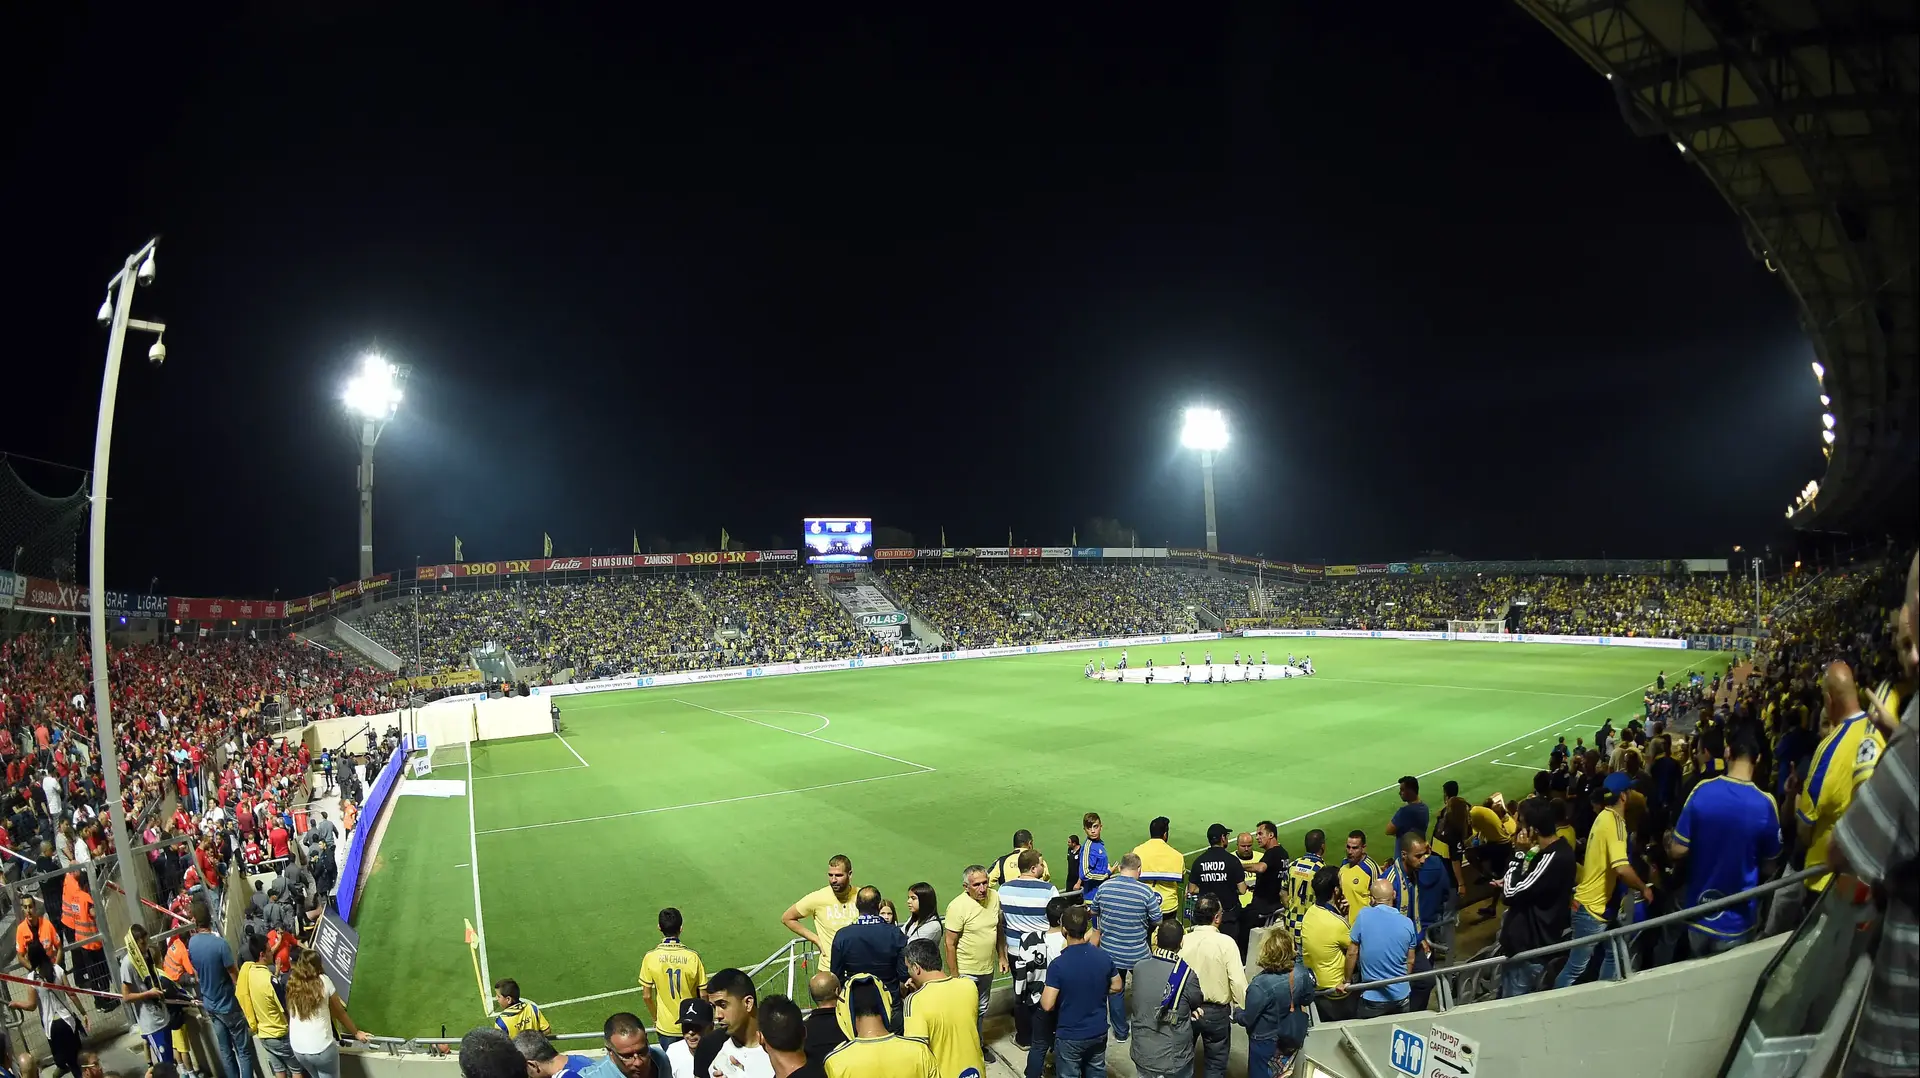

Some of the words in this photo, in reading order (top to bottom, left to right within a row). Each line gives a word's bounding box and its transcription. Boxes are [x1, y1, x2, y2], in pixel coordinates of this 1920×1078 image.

[591, 556, 633, 568] SAMSUNG
[644, 555, 674, 565] ZANUSSI
[686, 553, 718, 564] סופר
[723, 552, 746, 563] אבי
[763, 551, 796, 561] Winner
[462, 562, 497, 576] סופר
[505, 561, 532, 573] אבי
[547, 559, 582, 571] Sauter
[32, 588, 57, 605] SUBARU
[105, 591, 128, 608] GRAF
[863, 614, 899, 625] DALAS
[1200, 861, 1226, 872] מטאור
[1200, 872, 1228, 883] אבטחה
[319, 923, 339, 959] NIVEA
[335, 940, 353, 975] MEN
[666, 967, 682, 1000] 11
[1429, 1041, 1458, 1060] CAFITERIA
